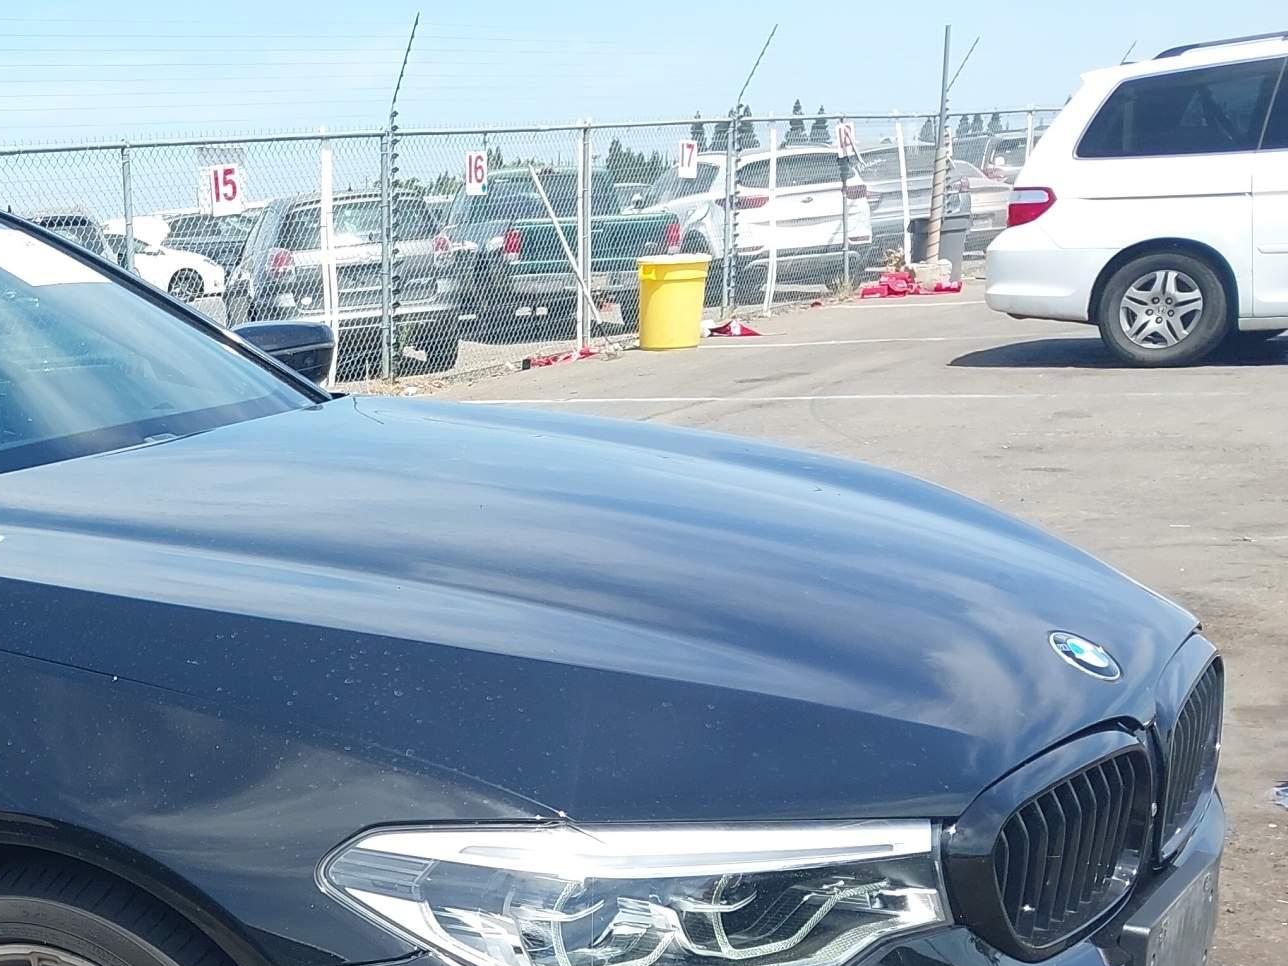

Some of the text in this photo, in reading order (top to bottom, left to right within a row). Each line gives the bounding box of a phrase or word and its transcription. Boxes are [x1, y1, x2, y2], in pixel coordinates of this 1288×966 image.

[468, 154, 485, 184] 16
[680, 142, 695, 168] 17
[213, 167, 237, 203] 15
